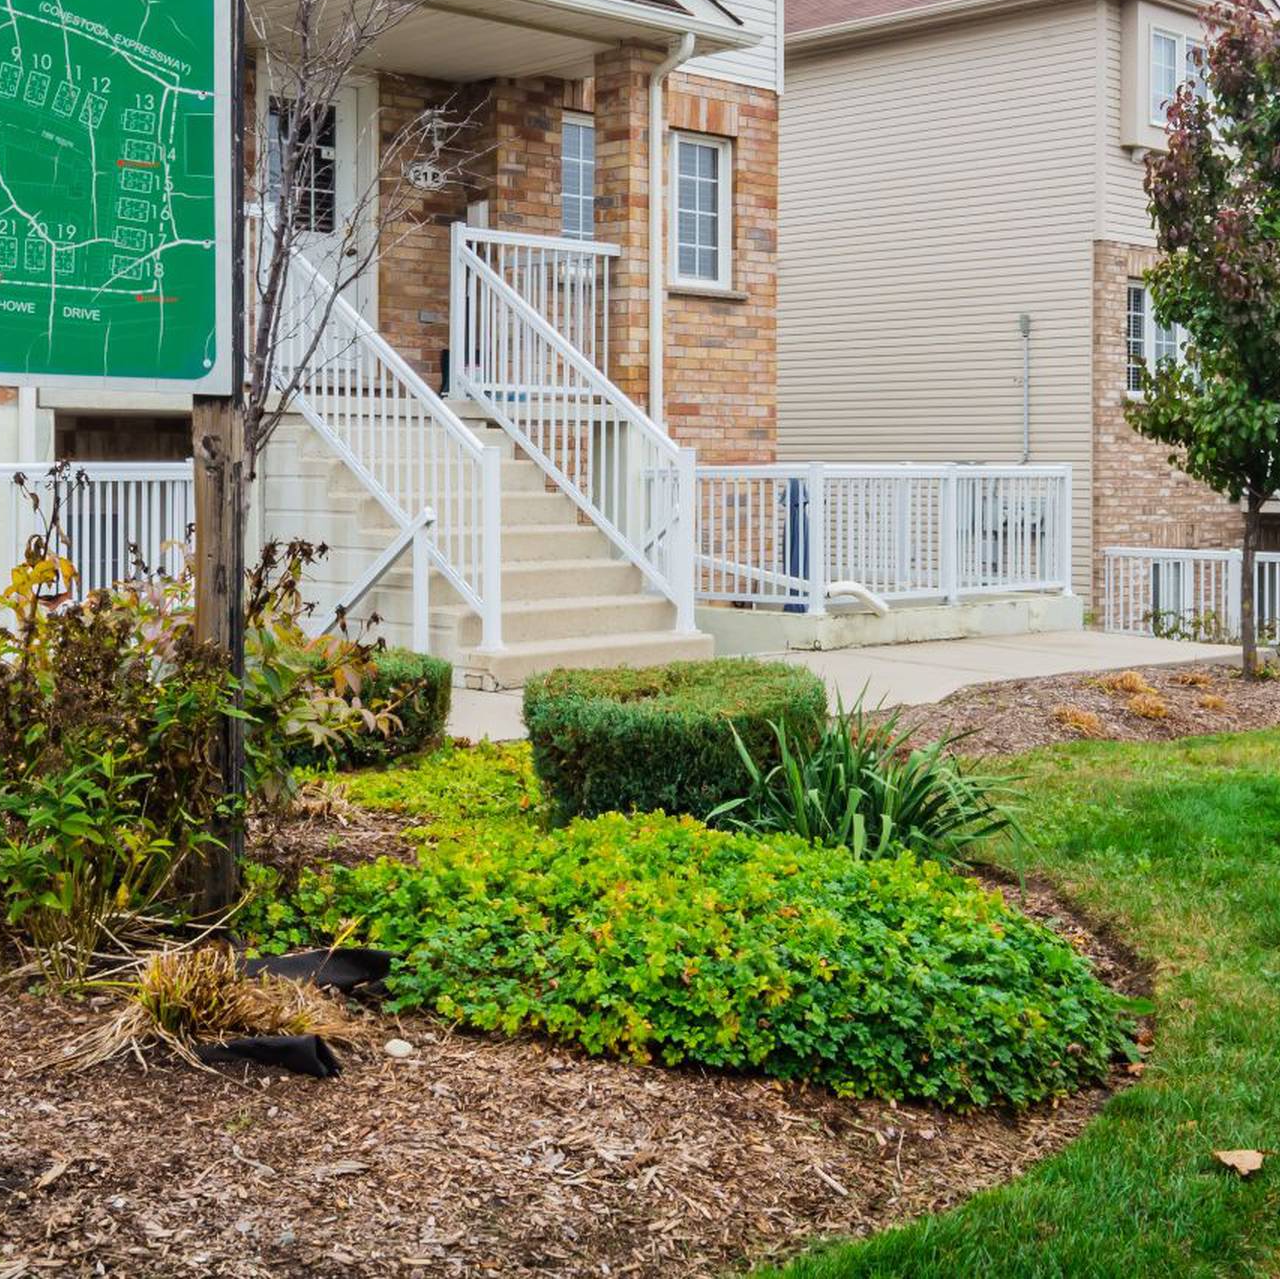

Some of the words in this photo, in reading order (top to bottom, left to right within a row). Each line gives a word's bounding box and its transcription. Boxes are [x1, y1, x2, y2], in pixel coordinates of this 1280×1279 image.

[11, 46, 21, 62] 9
[32, 53, 52, 70] 10
[92, 77, 112, 93] 12
[136, 93, 155, 110] 13
[151, 205, 171, 221] 16
[58, 224, 77, 240] 19
[146, 262, 164, 279] 18
[63, 306, 101, 322] DRIVE
